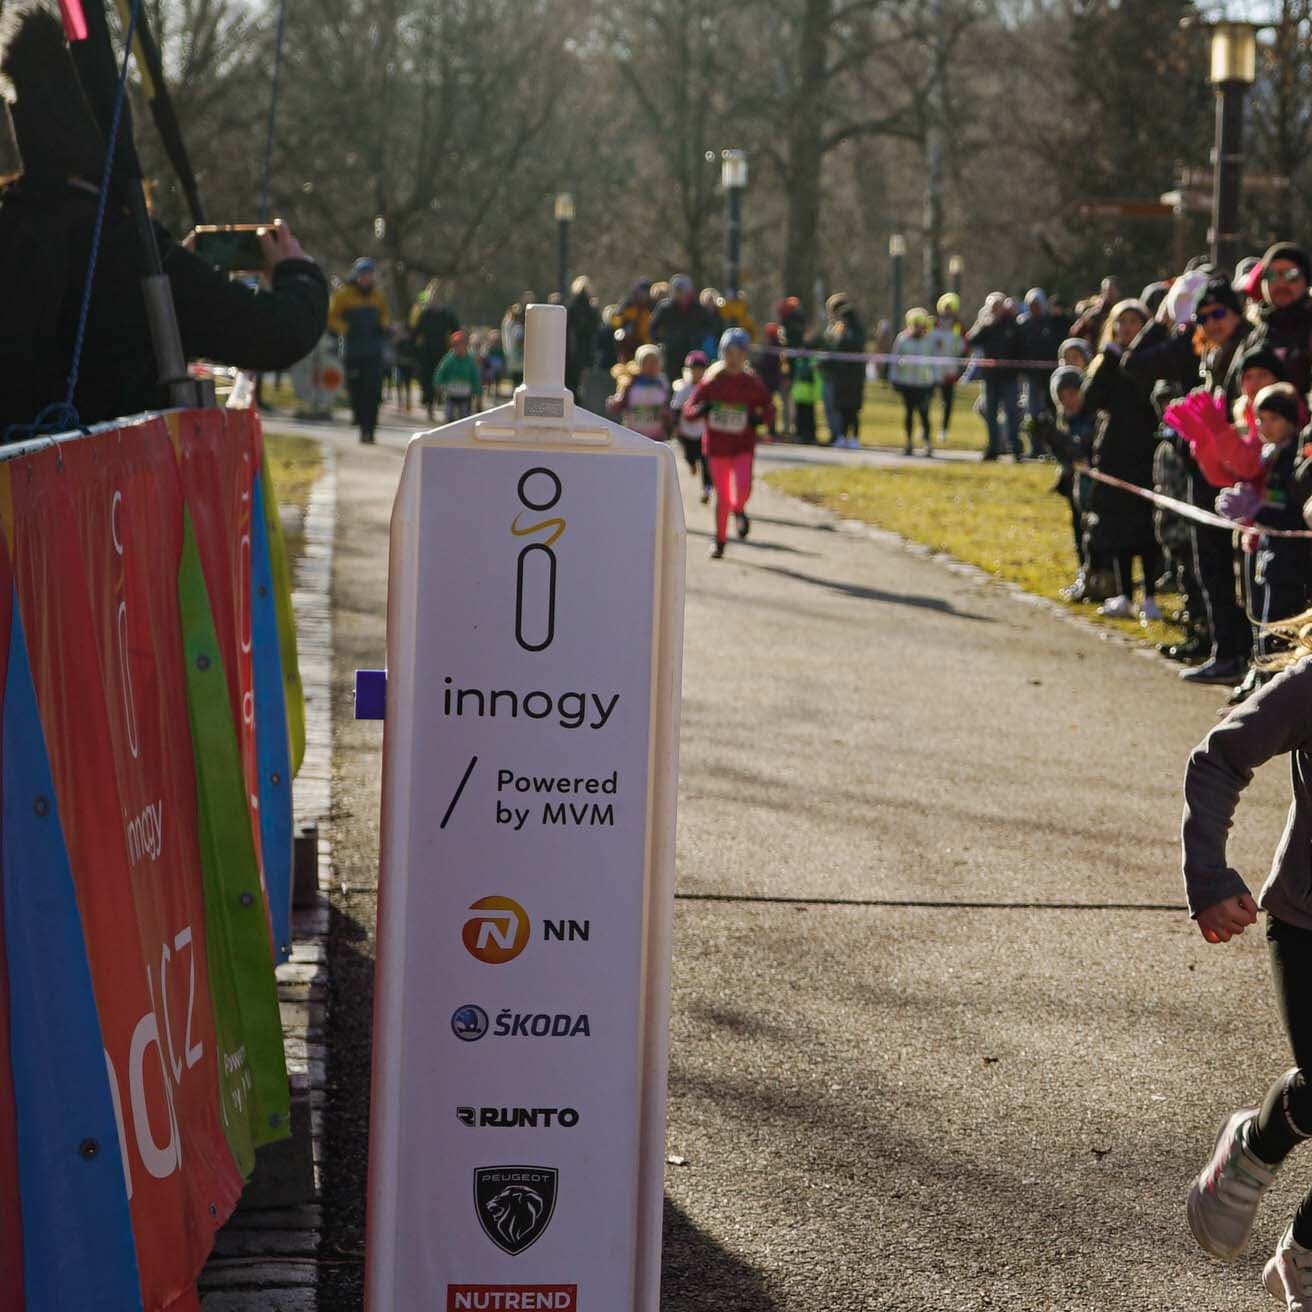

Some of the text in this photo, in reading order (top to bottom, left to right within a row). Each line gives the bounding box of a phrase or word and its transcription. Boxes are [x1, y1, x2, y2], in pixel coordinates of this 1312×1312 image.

[443, 677, 620, 730] innogy
[497, 769, 618, 795] Powered
[496, 800, 615, 831] by MVM
[543, 919, 590, 941] NN
[494, 1008, 591, 1037] ŠKODA
[480, 1107, 580, 1128] RUNTO
[481, 1173, 550, 1183] PEUGEOT
[454, 1291, 571, 1310] NUTREND
